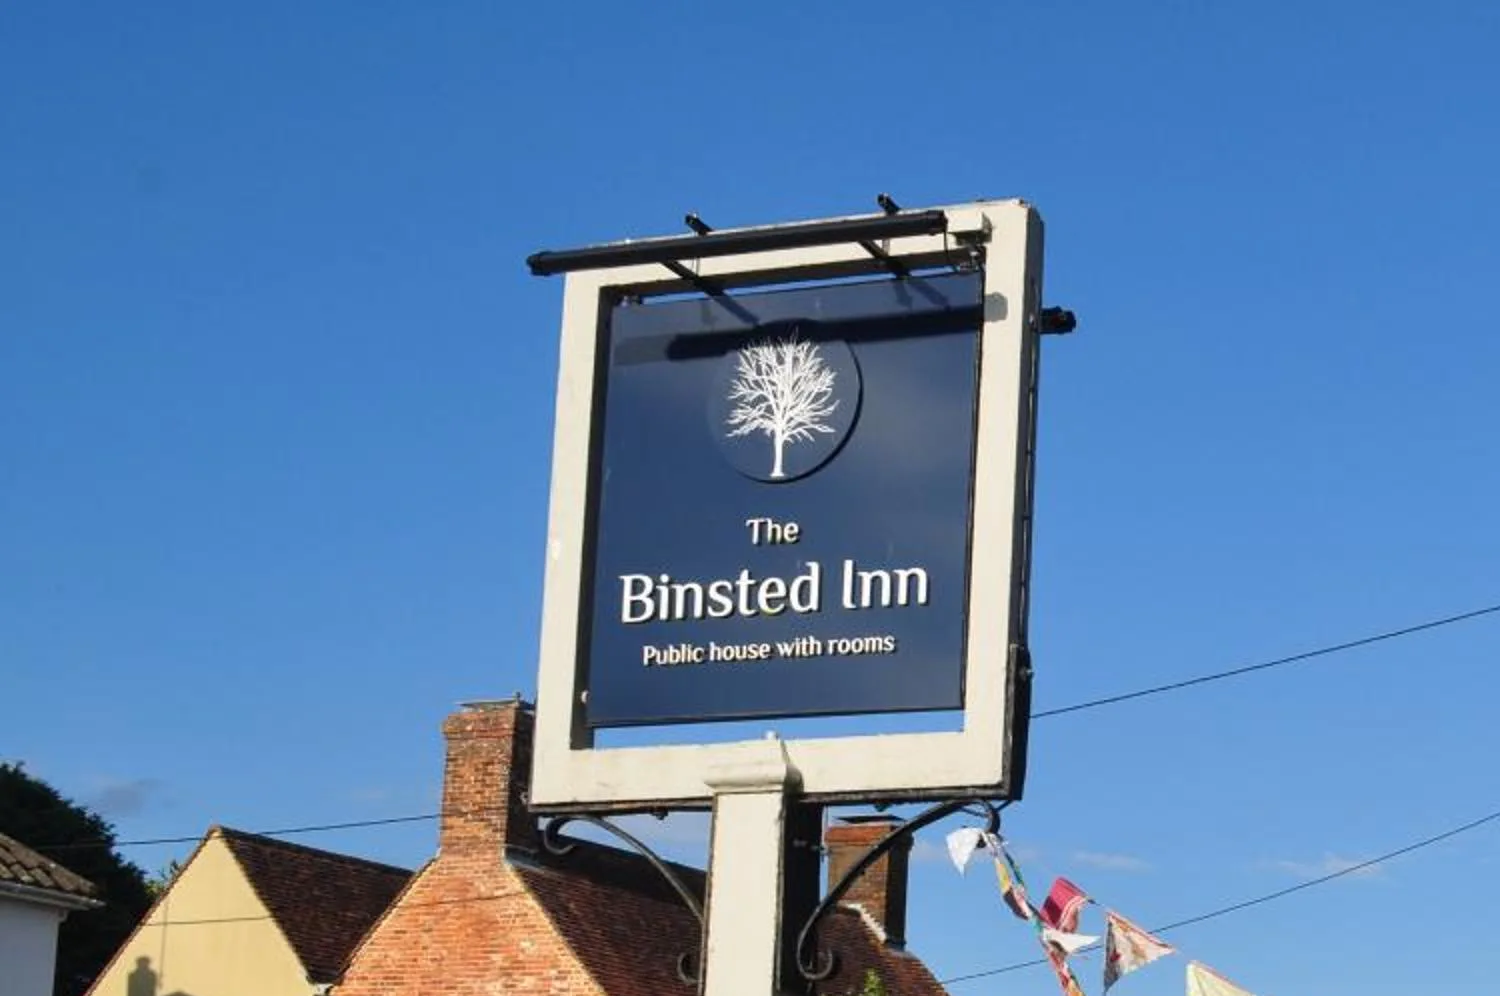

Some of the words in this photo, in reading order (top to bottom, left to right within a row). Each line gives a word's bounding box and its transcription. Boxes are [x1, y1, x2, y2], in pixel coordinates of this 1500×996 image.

[746, 517, 799, 545] The
[620, 561, 820, 624] Binsted
[842, 559, 929, 609] Inn
[643, 643, 705, 667] Public
[709, 640, 771, 663] house
[775, 635, 822, 657] with
[827, 634, 895, 656] rooms
